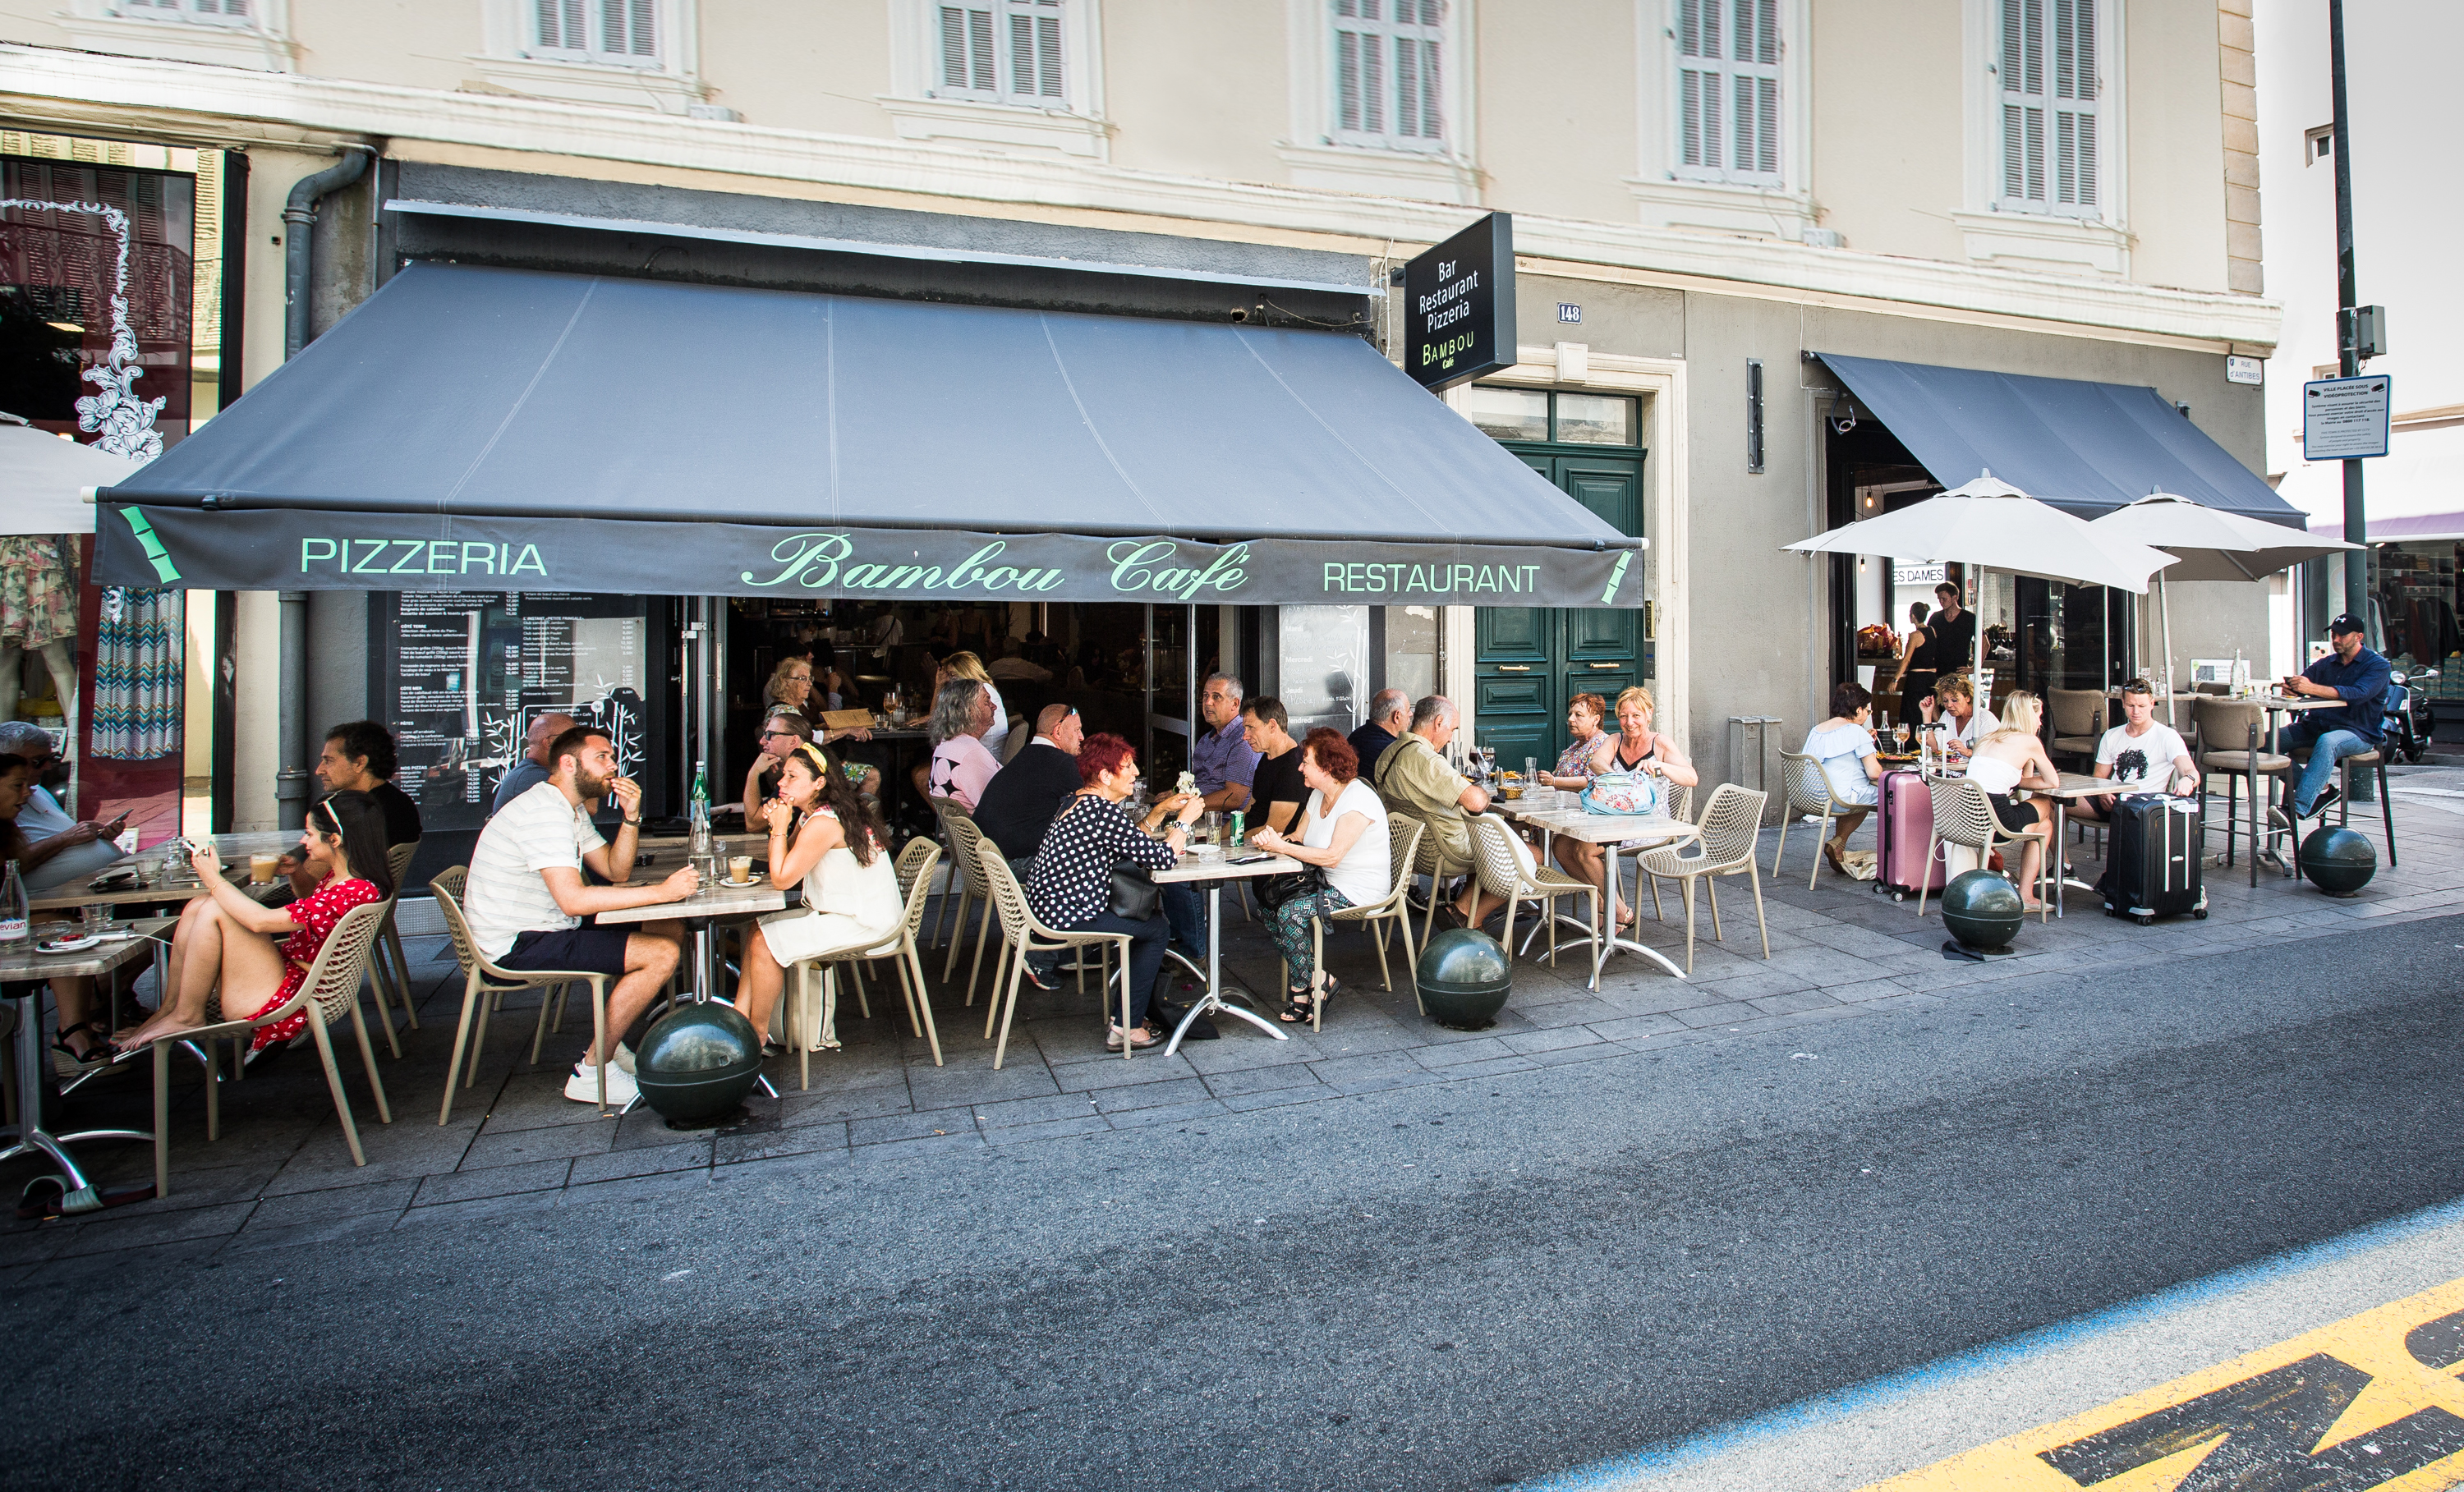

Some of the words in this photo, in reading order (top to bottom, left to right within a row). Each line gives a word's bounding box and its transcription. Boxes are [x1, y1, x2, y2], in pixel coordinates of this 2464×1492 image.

[1439, 259, 1456, 282] Bar
[1419, 270, 1478, 314] Restaurant
[1427, 301, 1469, 333] Pizzeria
[1561, 306, 1579, 321] 148
[1423, 332, 1473, 365] BAMBOU
[1442, 357, 1454, 370] Café
[2230, 370, 2260, 380] d'ANTIBES
[300, 538, 549, 577] PIZZERIA
[741, 533, 1065, 592] Bambou
[1106, 540, 1252, 600] Café
[1323, 562, 1540, 593] RESTAURANT
[1907, 568, 1944, 581] DAMES
[0, 921, 26, 931] evian
